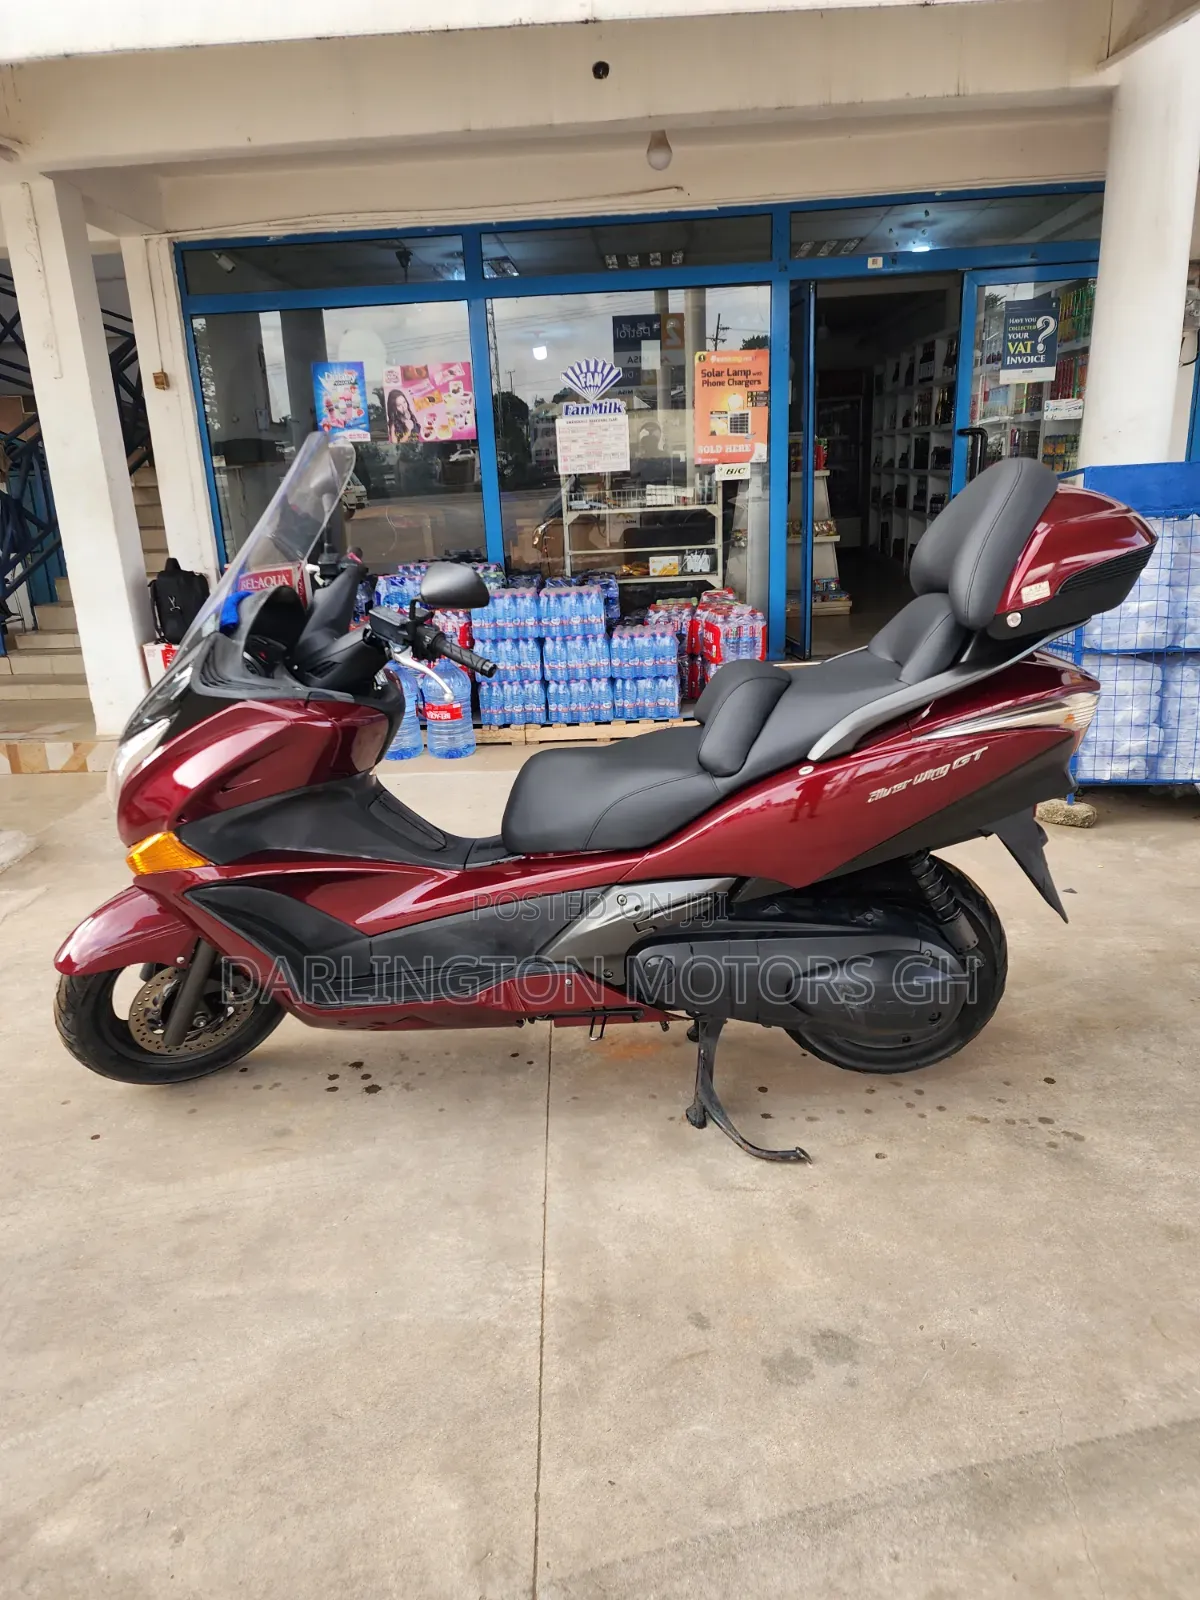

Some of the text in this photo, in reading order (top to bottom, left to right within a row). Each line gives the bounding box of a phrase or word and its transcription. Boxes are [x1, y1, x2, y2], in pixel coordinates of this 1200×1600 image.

[1008, 332, 1029, 340] YOUR
[1007, 341, 1034, 355] VAT
[1007, 355, 1046, 365] INVOICE
[701, 368, 725, 378] Solar
[727, 367, 751, 379] Lamp
[579, 371, 603, 388] FAN
[702, 378, 762, 388] Phone Chargers
[698, 443, 752, 454] SOLD HERE
[952, 746, 989, 770] GT
